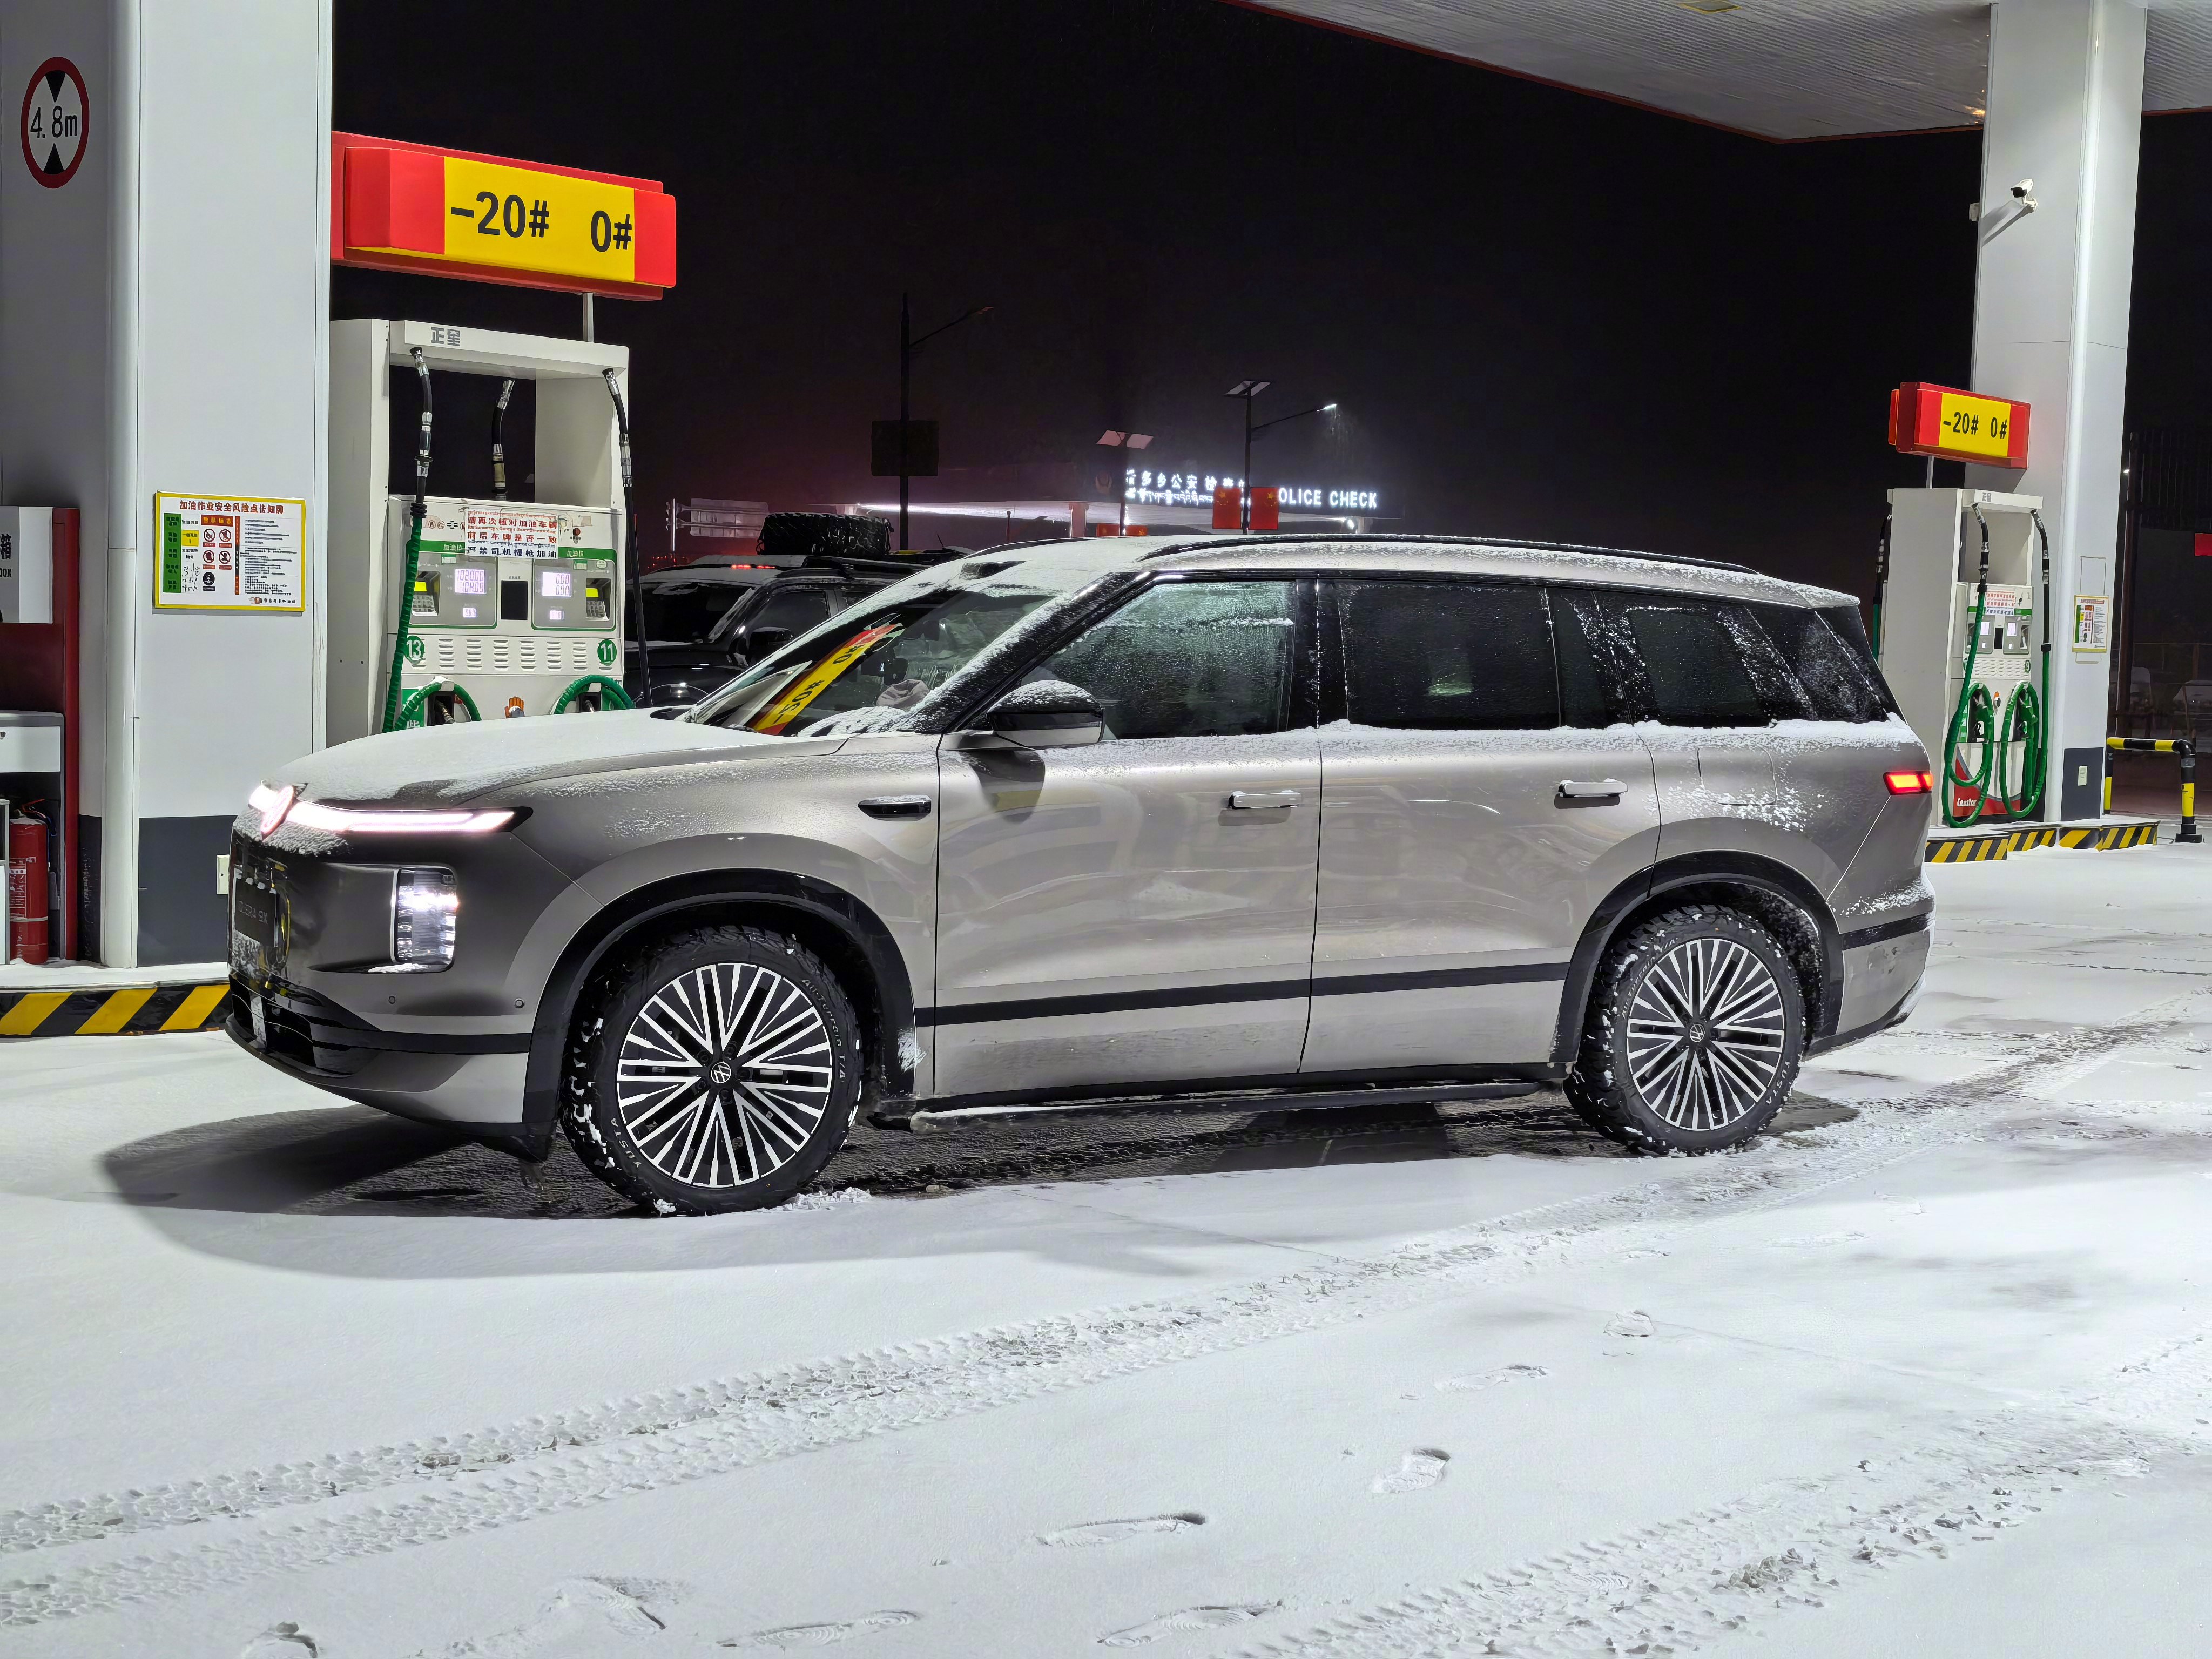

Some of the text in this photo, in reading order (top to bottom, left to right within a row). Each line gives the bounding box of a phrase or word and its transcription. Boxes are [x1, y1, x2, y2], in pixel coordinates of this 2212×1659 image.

[30, 105, 77, 138] 4.8m
[451, 191, 632, 252] -20# 0#
[1943, 412, 2007, 439] -20# 0#
[1278, 488, 1377, 509] OLICE CHECK
[0, 534, 11, 559] 箱
[468, 531, 557, 544] 前后车牌是否一致
[468, 546, 556, 558] 严禁司机提枪加油
[407, 639, 421, 658] 13
[601, 643, 613, 660] 11
